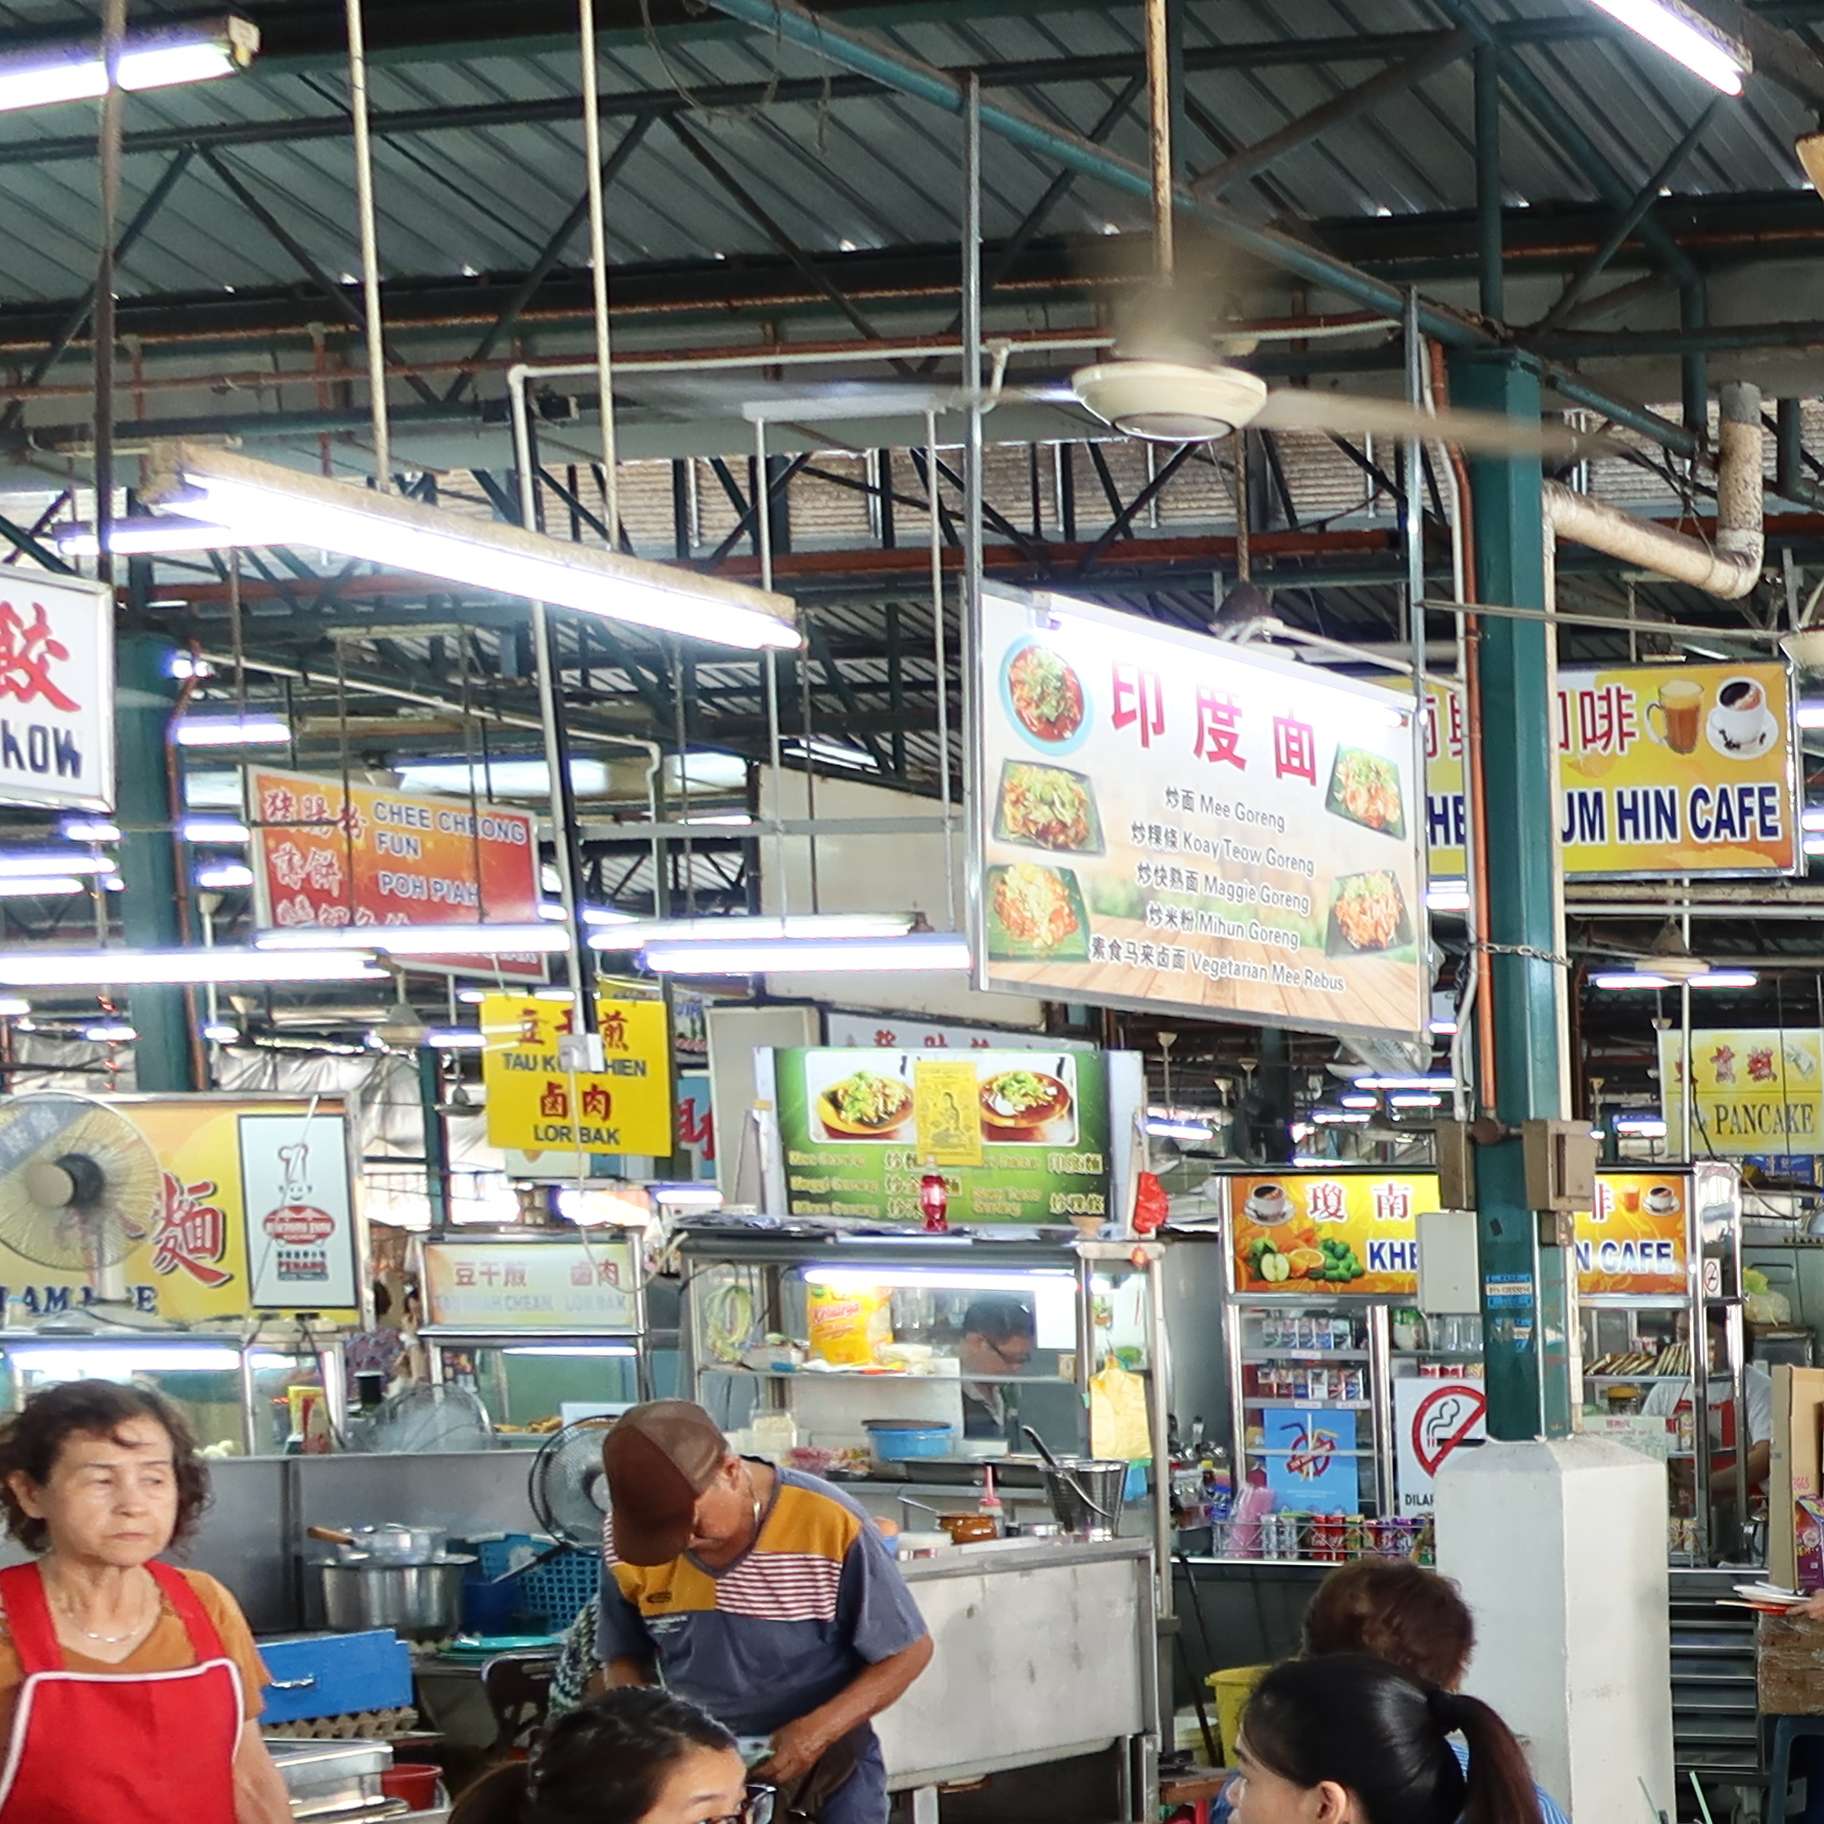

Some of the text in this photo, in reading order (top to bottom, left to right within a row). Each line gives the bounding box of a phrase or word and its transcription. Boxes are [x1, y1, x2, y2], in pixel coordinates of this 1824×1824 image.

[1111, 660, 1318, 787] 印度面
[374, 802, 527, 845] CHEE CHEONG
[1200, 793, 1286, 833] Mee Goreng
[1616, 788, 1679, 841] HIN
[1689, 786, 1781, 839] CAFE
[377, 832, 422, 858] FUN
[1183, 831, 1315, 877] Koay Teow Goreng
[379, 871, 480, 908] POH PIAH
[1204, 875, 1310, 914] Maggie Goreng
[1199, 914, 1299, 950] Mihun Goreng
[1192, 952, 1345, 991] Vegetarian Mee Rebus
[502, 1053, 537, 1071] TAU
[597, 1057, 647, 1077] HIEN
[533, 1125, 620, 1145] LOR BAK
[1715, 1103, 1815, 1135] PANCAKE
[1601, 1242, 1672, 1274] CAFE
